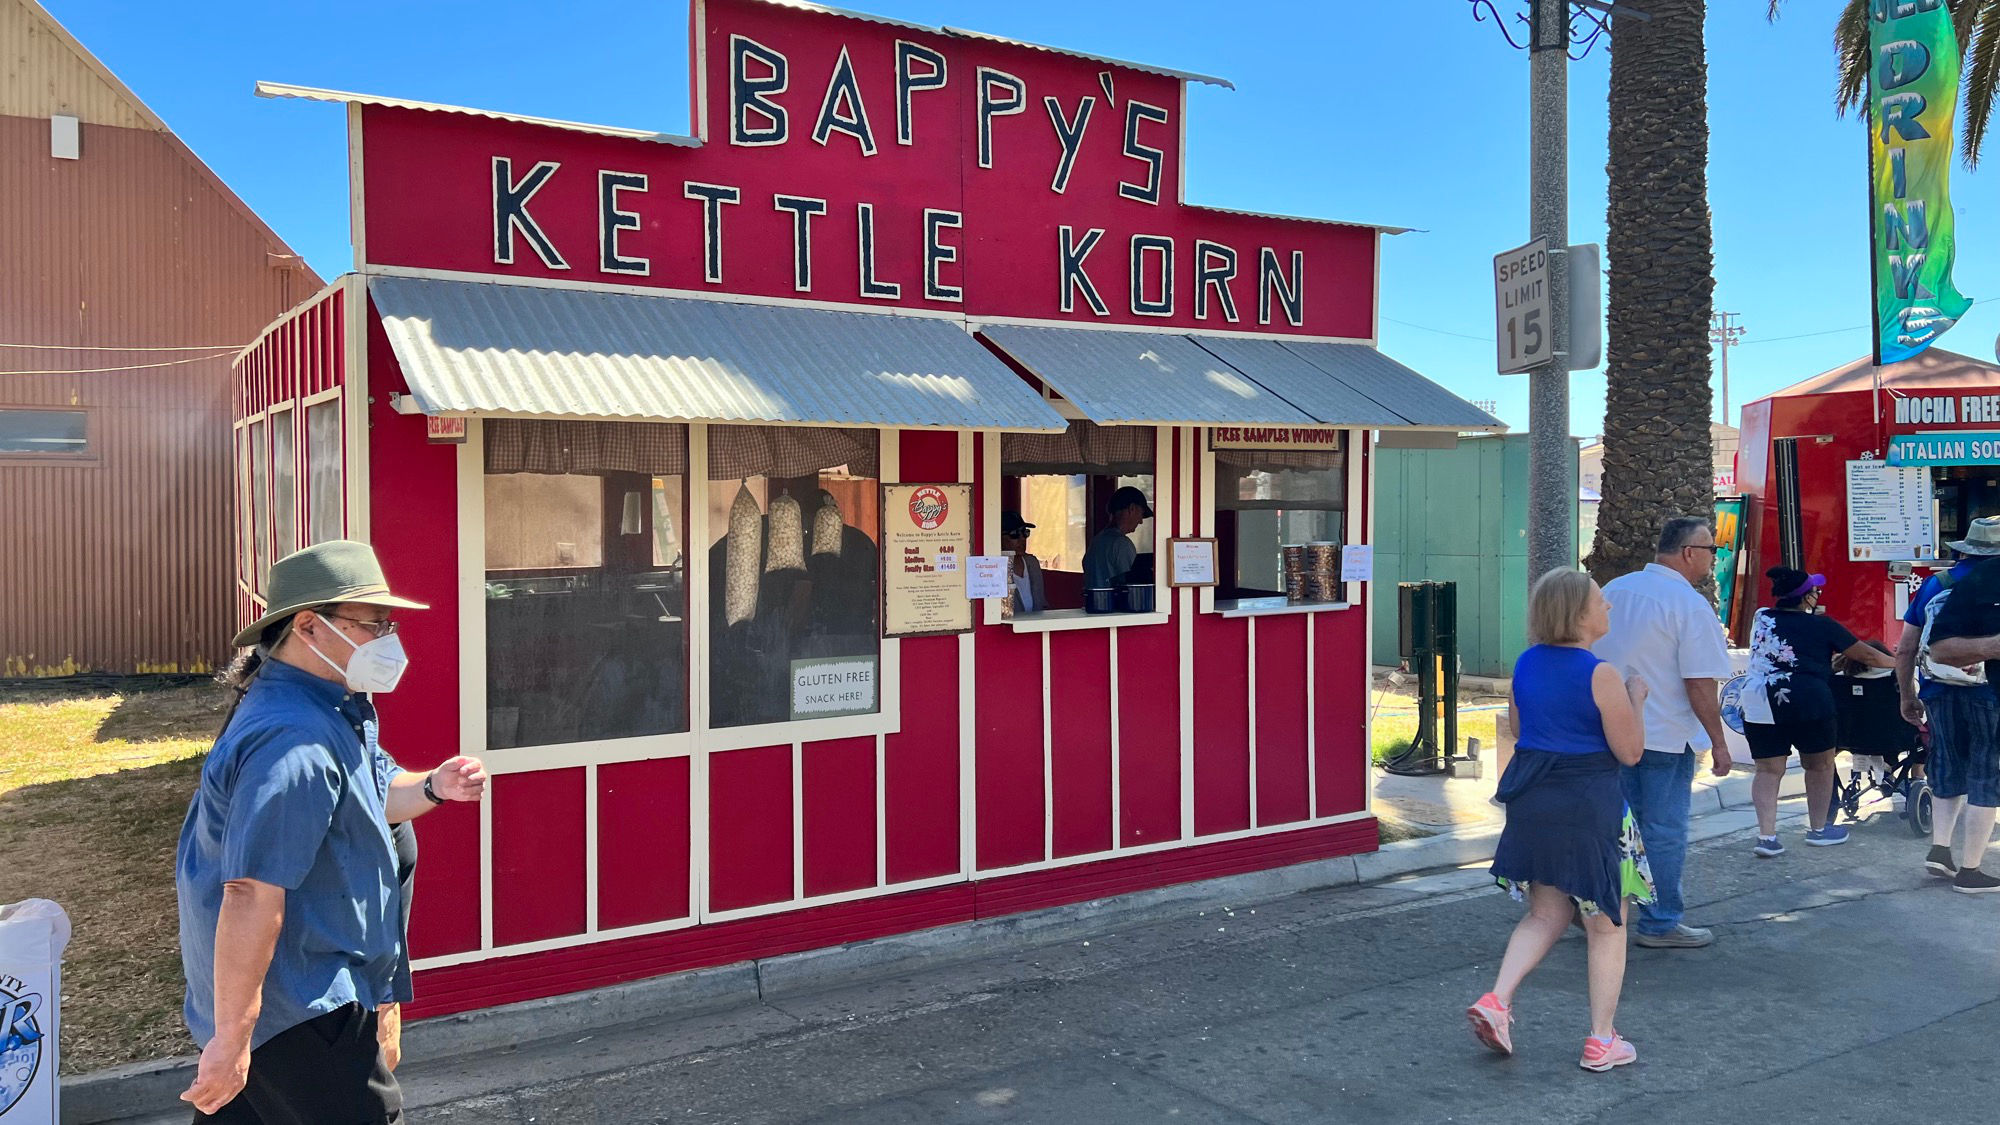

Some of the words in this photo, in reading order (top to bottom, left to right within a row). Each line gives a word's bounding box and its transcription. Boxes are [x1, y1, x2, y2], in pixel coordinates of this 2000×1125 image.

[730, 33, 1168, 205] BAPPY'S
[492, 155, 963, 302] KETTLE
[1059, 224, 1304, 326] KORN
[1500, 250, 1546, 282] SPEED
[1505, 279, 1543, 309] LIMIT
[1507, 308, 1543, 360] 15
[1895, 396, 1956, 424] MOCHA
[1216, 427, 1241, 442] FREE
[1243, 427, 1290, 443] SAMPLES
[1292, 428, 1335, 444] WINDOW
[1901, 441, 1965, 460] ITALIAN
[798, 674, 842, 686] GLUTEN
[846, 671, 870, 683] FREE
[805, 694, 836, 705] SNACK
[838, 691, 863, 702] HERE!
